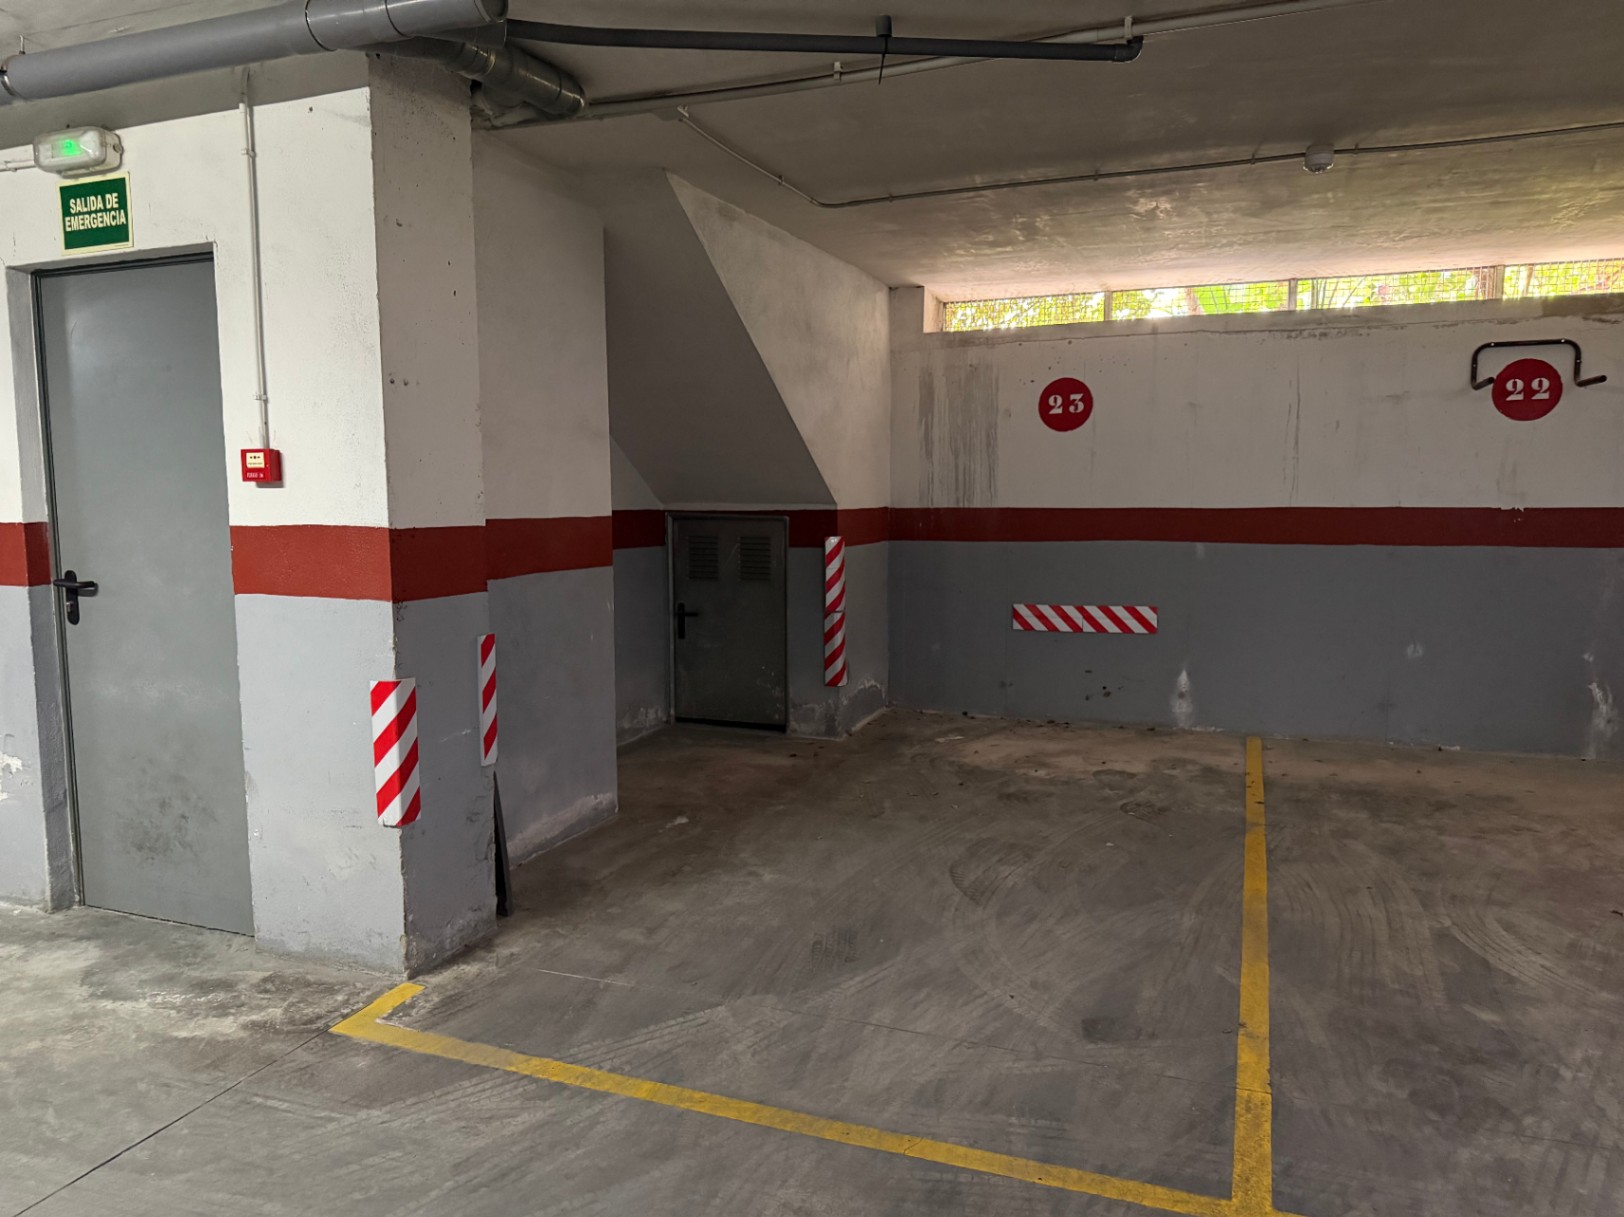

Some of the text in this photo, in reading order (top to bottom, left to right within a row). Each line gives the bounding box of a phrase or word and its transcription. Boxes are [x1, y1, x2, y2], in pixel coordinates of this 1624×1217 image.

[69, 193, 119, 214] SALIDA DE
[65, 209, 126, 231] EMERGENCIA
[1505, 377, 1550, 401] 22
[1048, 393, 1085, 414] 23
